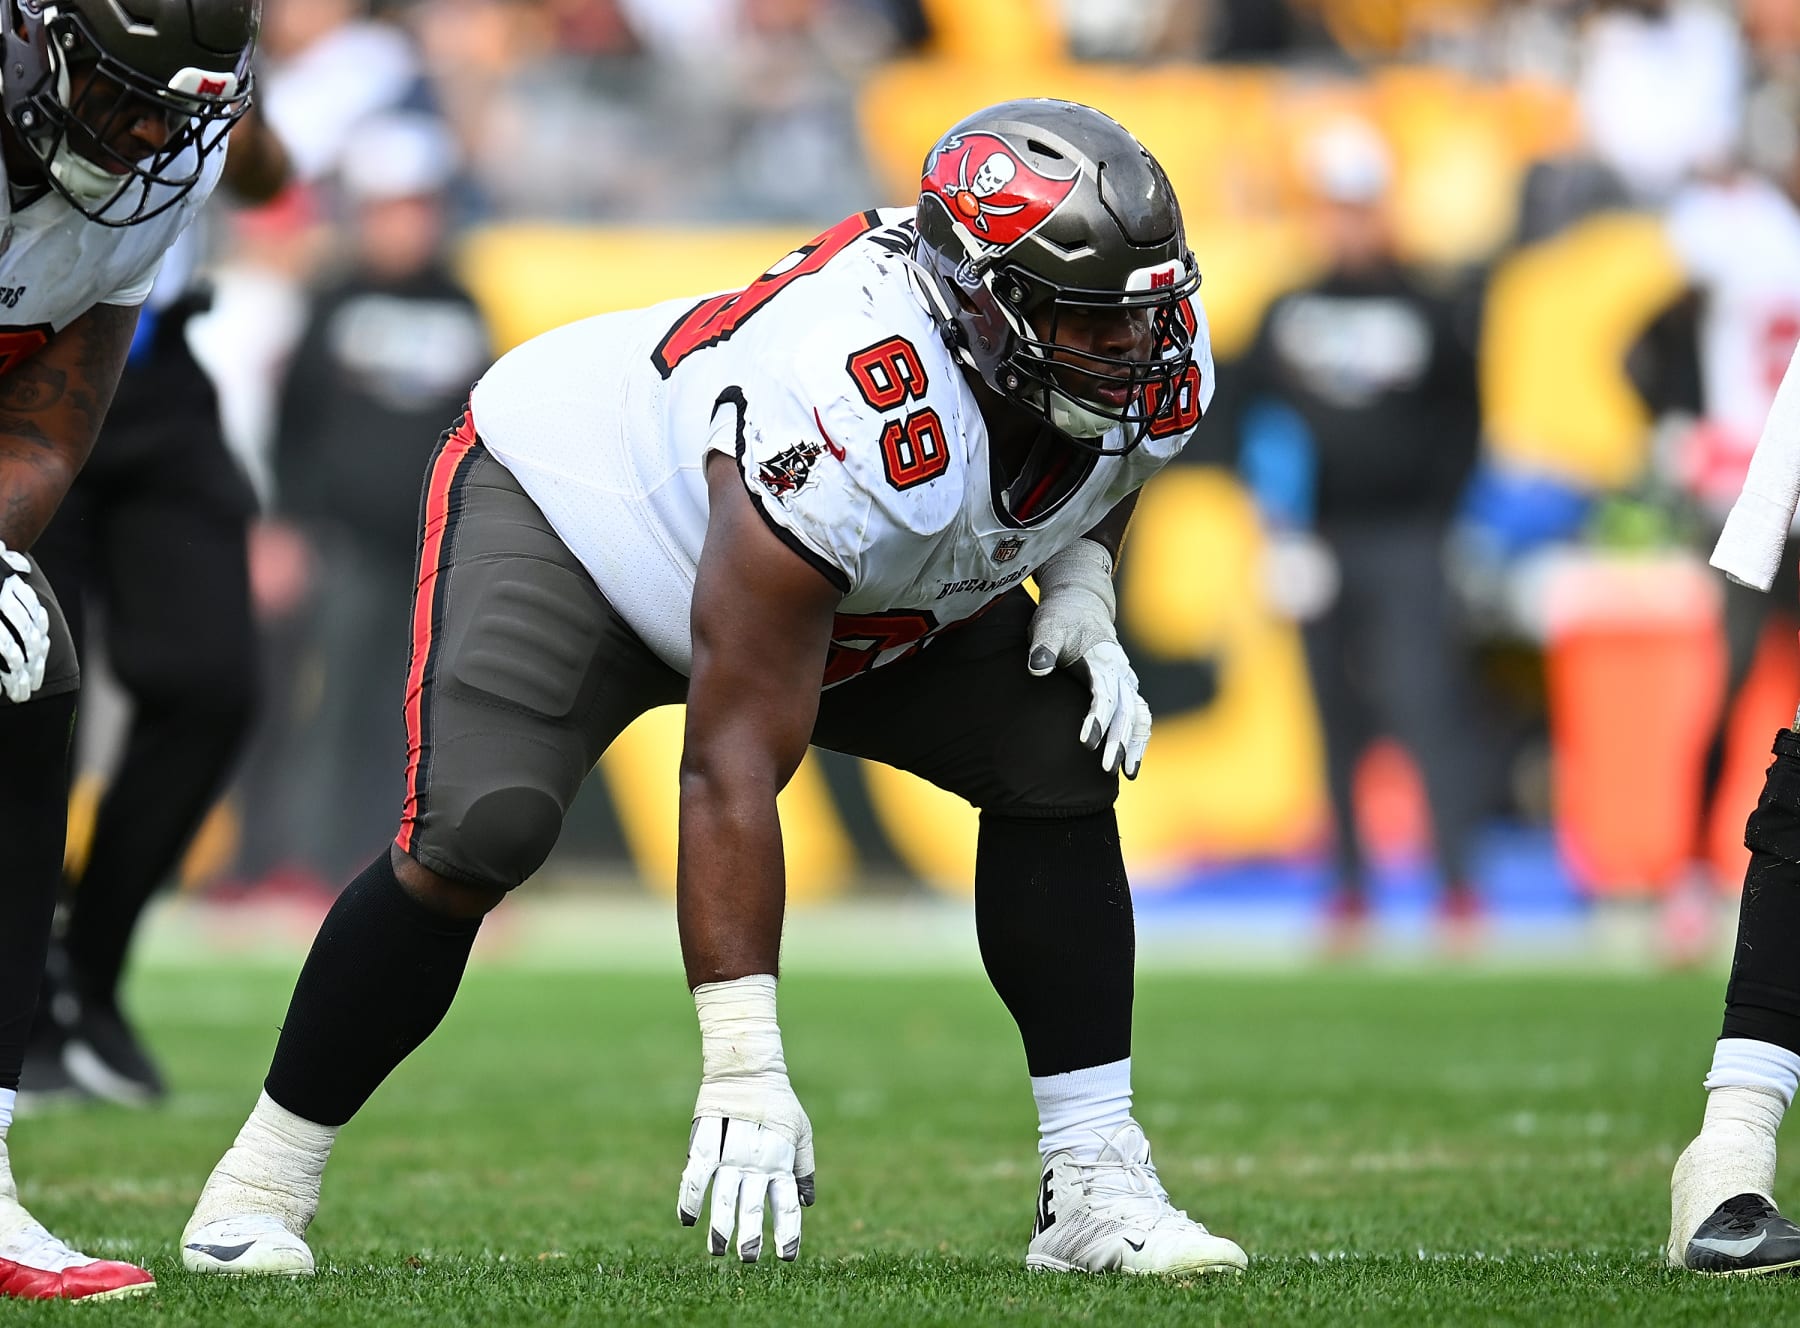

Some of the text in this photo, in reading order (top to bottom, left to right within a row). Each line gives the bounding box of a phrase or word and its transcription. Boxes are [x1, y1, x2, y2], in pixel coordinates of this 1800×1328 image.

[846, 333, 951, 492] 69
[995, 548, 1018, 560] NFL
[935, 564, 1029, 600] BUCCANEERS
